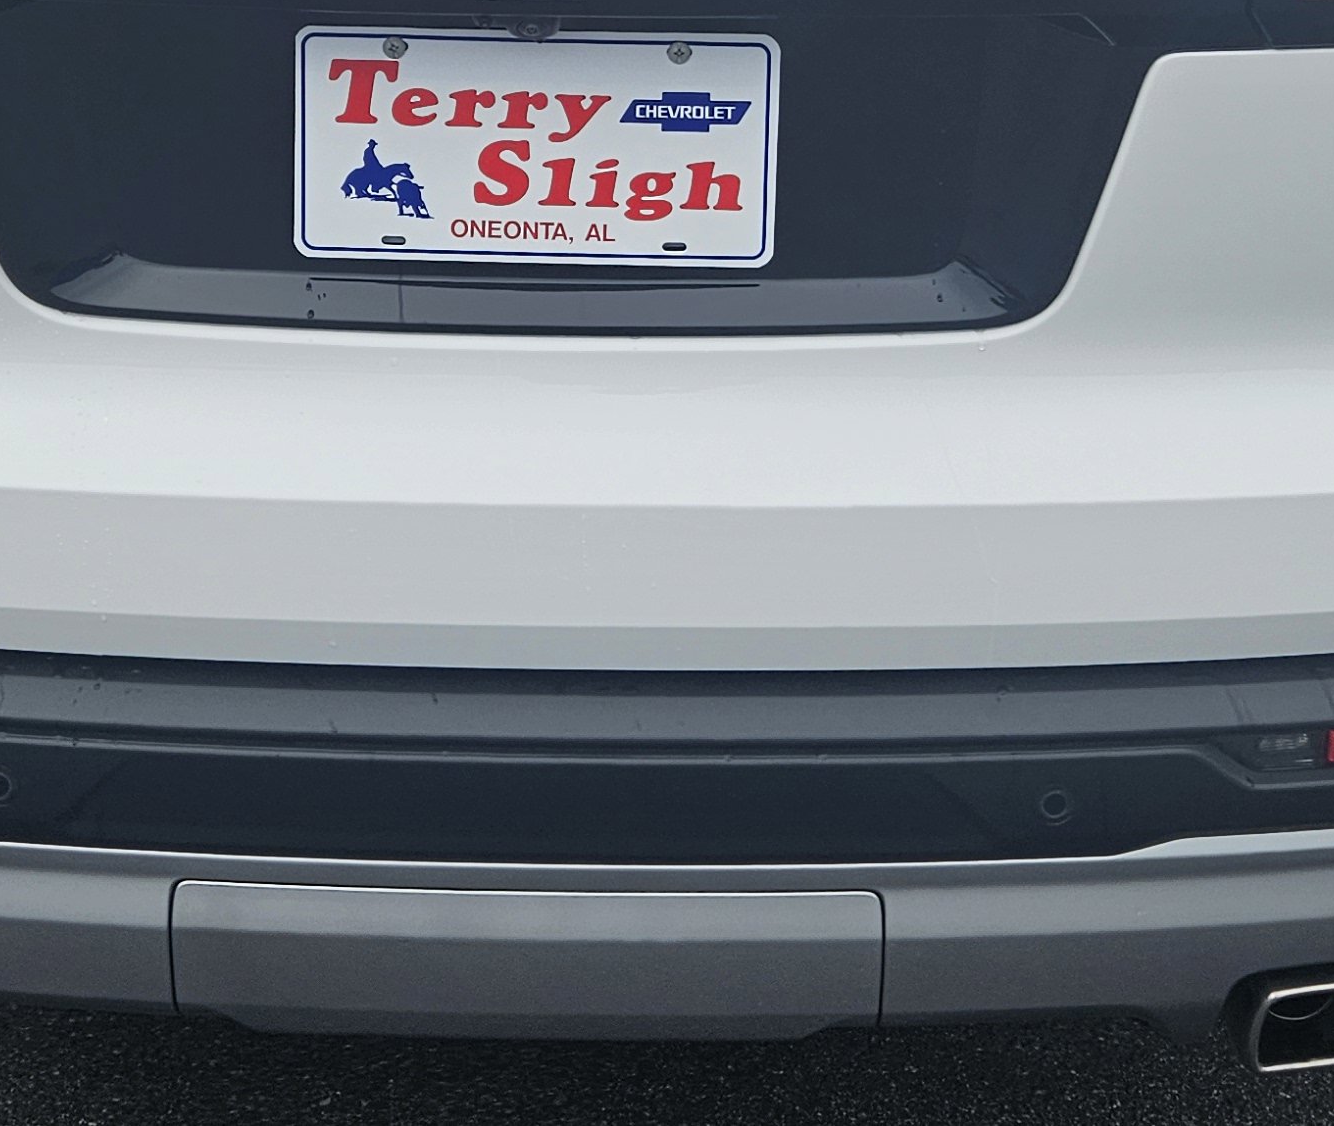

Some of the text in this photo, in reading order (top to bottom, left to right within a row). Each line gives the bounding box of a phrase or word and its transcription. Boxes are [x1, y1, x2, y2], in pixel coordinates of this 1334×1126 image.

[328, 58, 612, 142] Terry
[634, 103, 737, 121] CHEVROLET
[473, 140, 744, 221] Sligh
[450, 218, 616, 244] ONEONTA, AL
